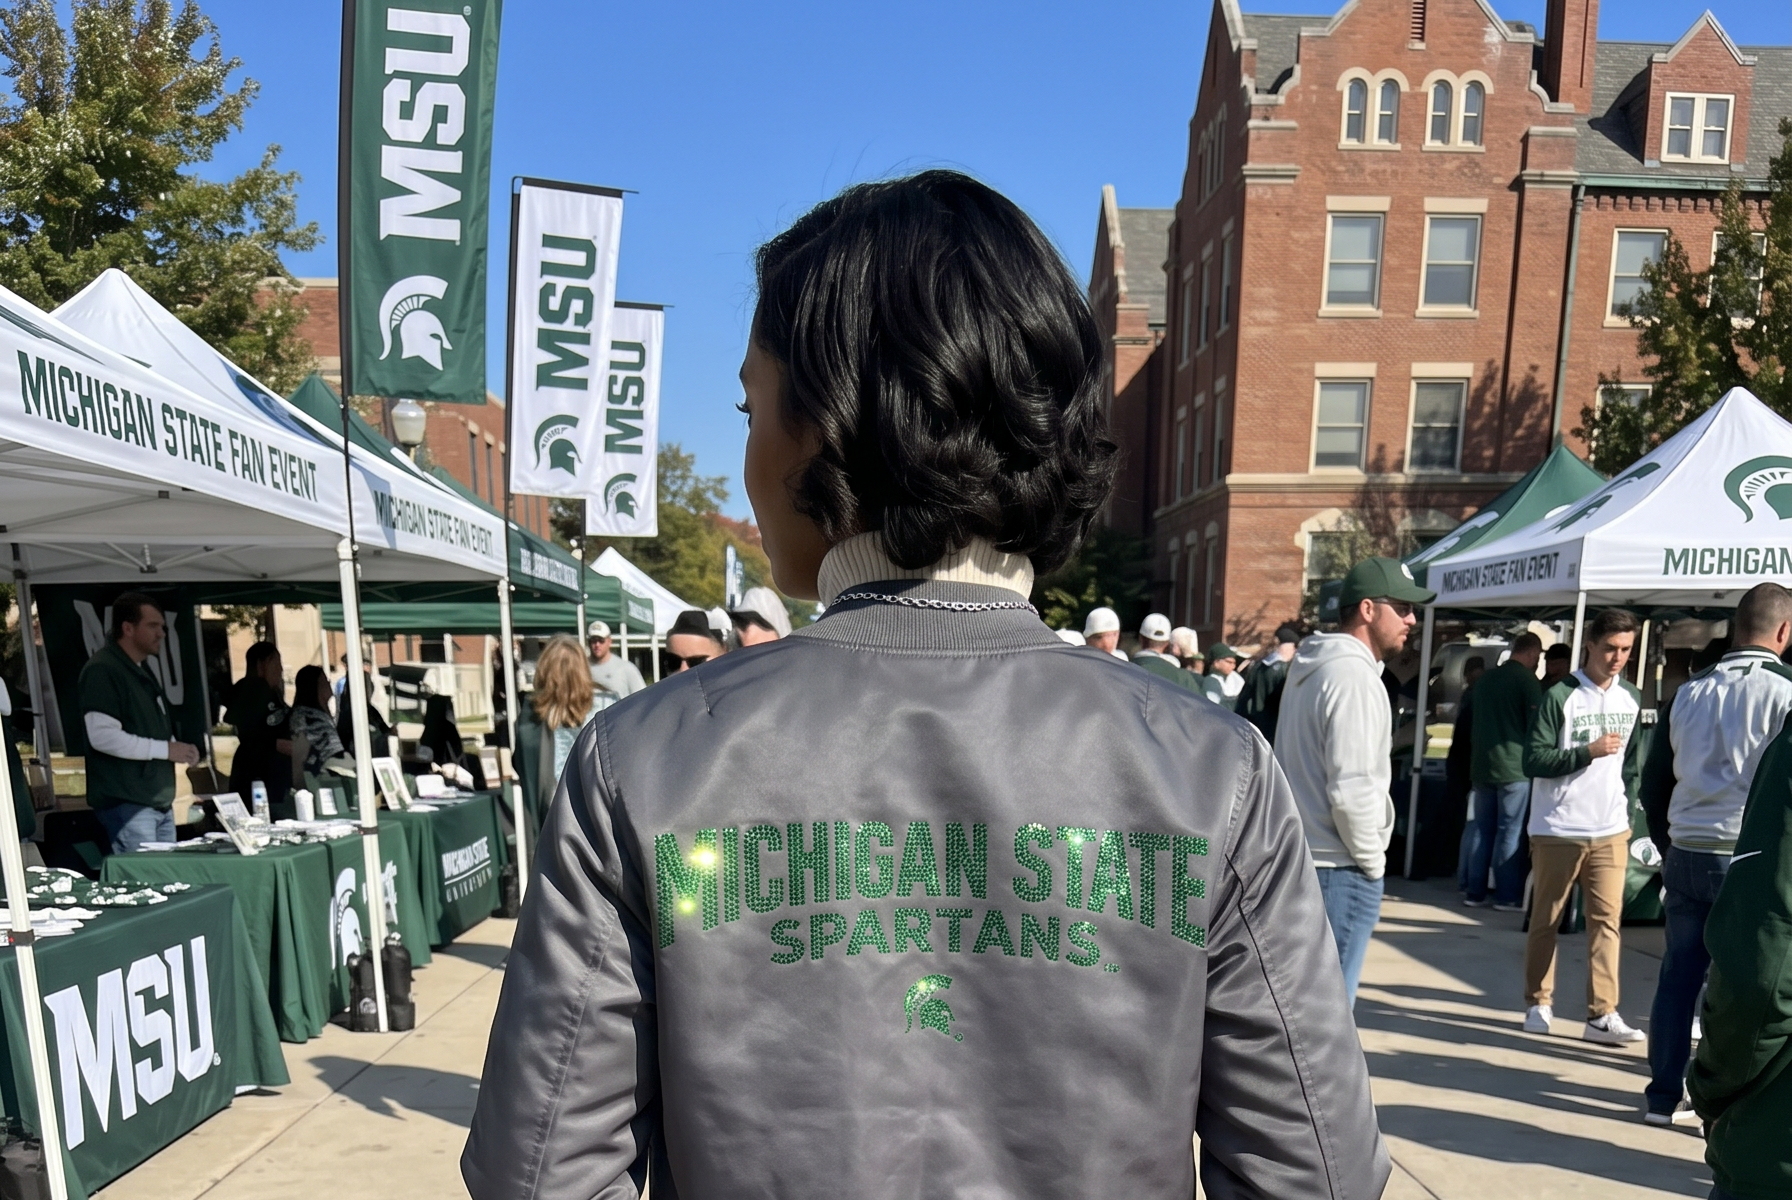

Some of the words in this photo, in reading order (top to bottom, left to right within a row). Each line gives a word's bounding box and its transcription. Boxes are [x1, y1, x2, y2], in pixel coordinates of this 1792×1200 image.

[380, 8, 471, 241] MSU
[536, 233, 597, 391] MSU
[17, 350, 158, 450] MICHIGAN
[161, 402, 226, 474] STATE
[228, 428, 266, 486] FAN
[267, 445, 318, 503] EVENT
[604, 340, 646, 455] MSU
[654, 821, 988, 949] MICHIGAN
[1013, 822, 1208, 949] STATE
[770, 907, 1101, 967] SPARTANS
[44, 935, 215, 1150] MSU
